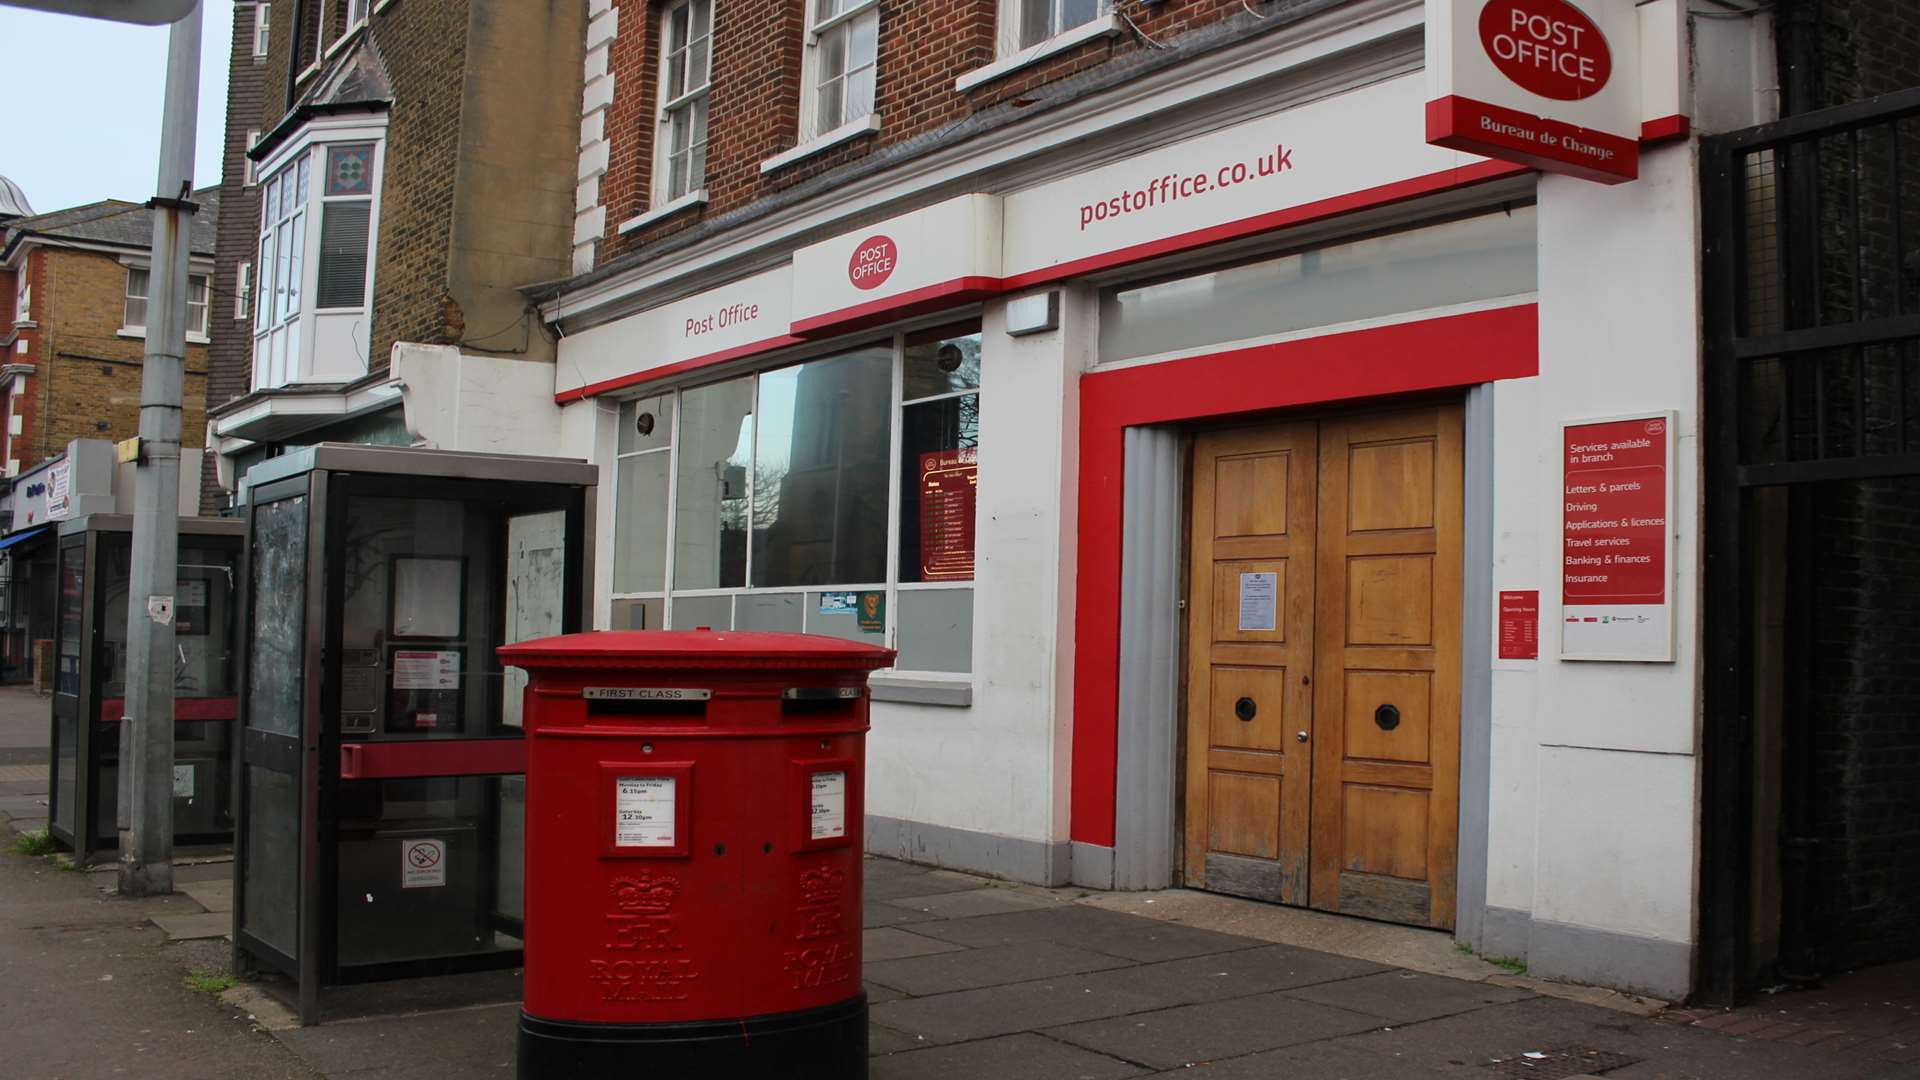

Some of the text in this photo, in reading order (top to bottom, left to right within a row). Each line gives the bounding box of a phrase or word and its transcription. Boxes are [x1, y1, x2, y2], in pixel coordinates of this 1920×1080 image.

[1511, 8, 1585, 49] POST
[1492, 34, 1596, 82] OFFICE
[1480, 115, 1614, 160] Bureau de Change
[1080, 144, 1293, 231] postoffice.co.uk
[859, 243, 888, 264] POST
[852, 257, 891, 281] OFFICE
[685, 303, 759, 338] Post Office
[1570, 438, 1651, 454] Services available
[1570, 452, 1614, 464] in branch
[1566, 481, 1641, 494] Letters & parcels
[1566, 502, 1598, 512] Driving
[1566, 517, 1665, 531] Applications & licences
[1566, 537, 1630, 547] Travel services
[1566, 554, 1651, 566] Banking & finances
[1565, 574, 1608, 583] Insurance
[600, 689, 682, 699] FIRST CLASS
[588, 959, 699, 980] ROYAL
[601, 981, 689, 1001] MAIL
